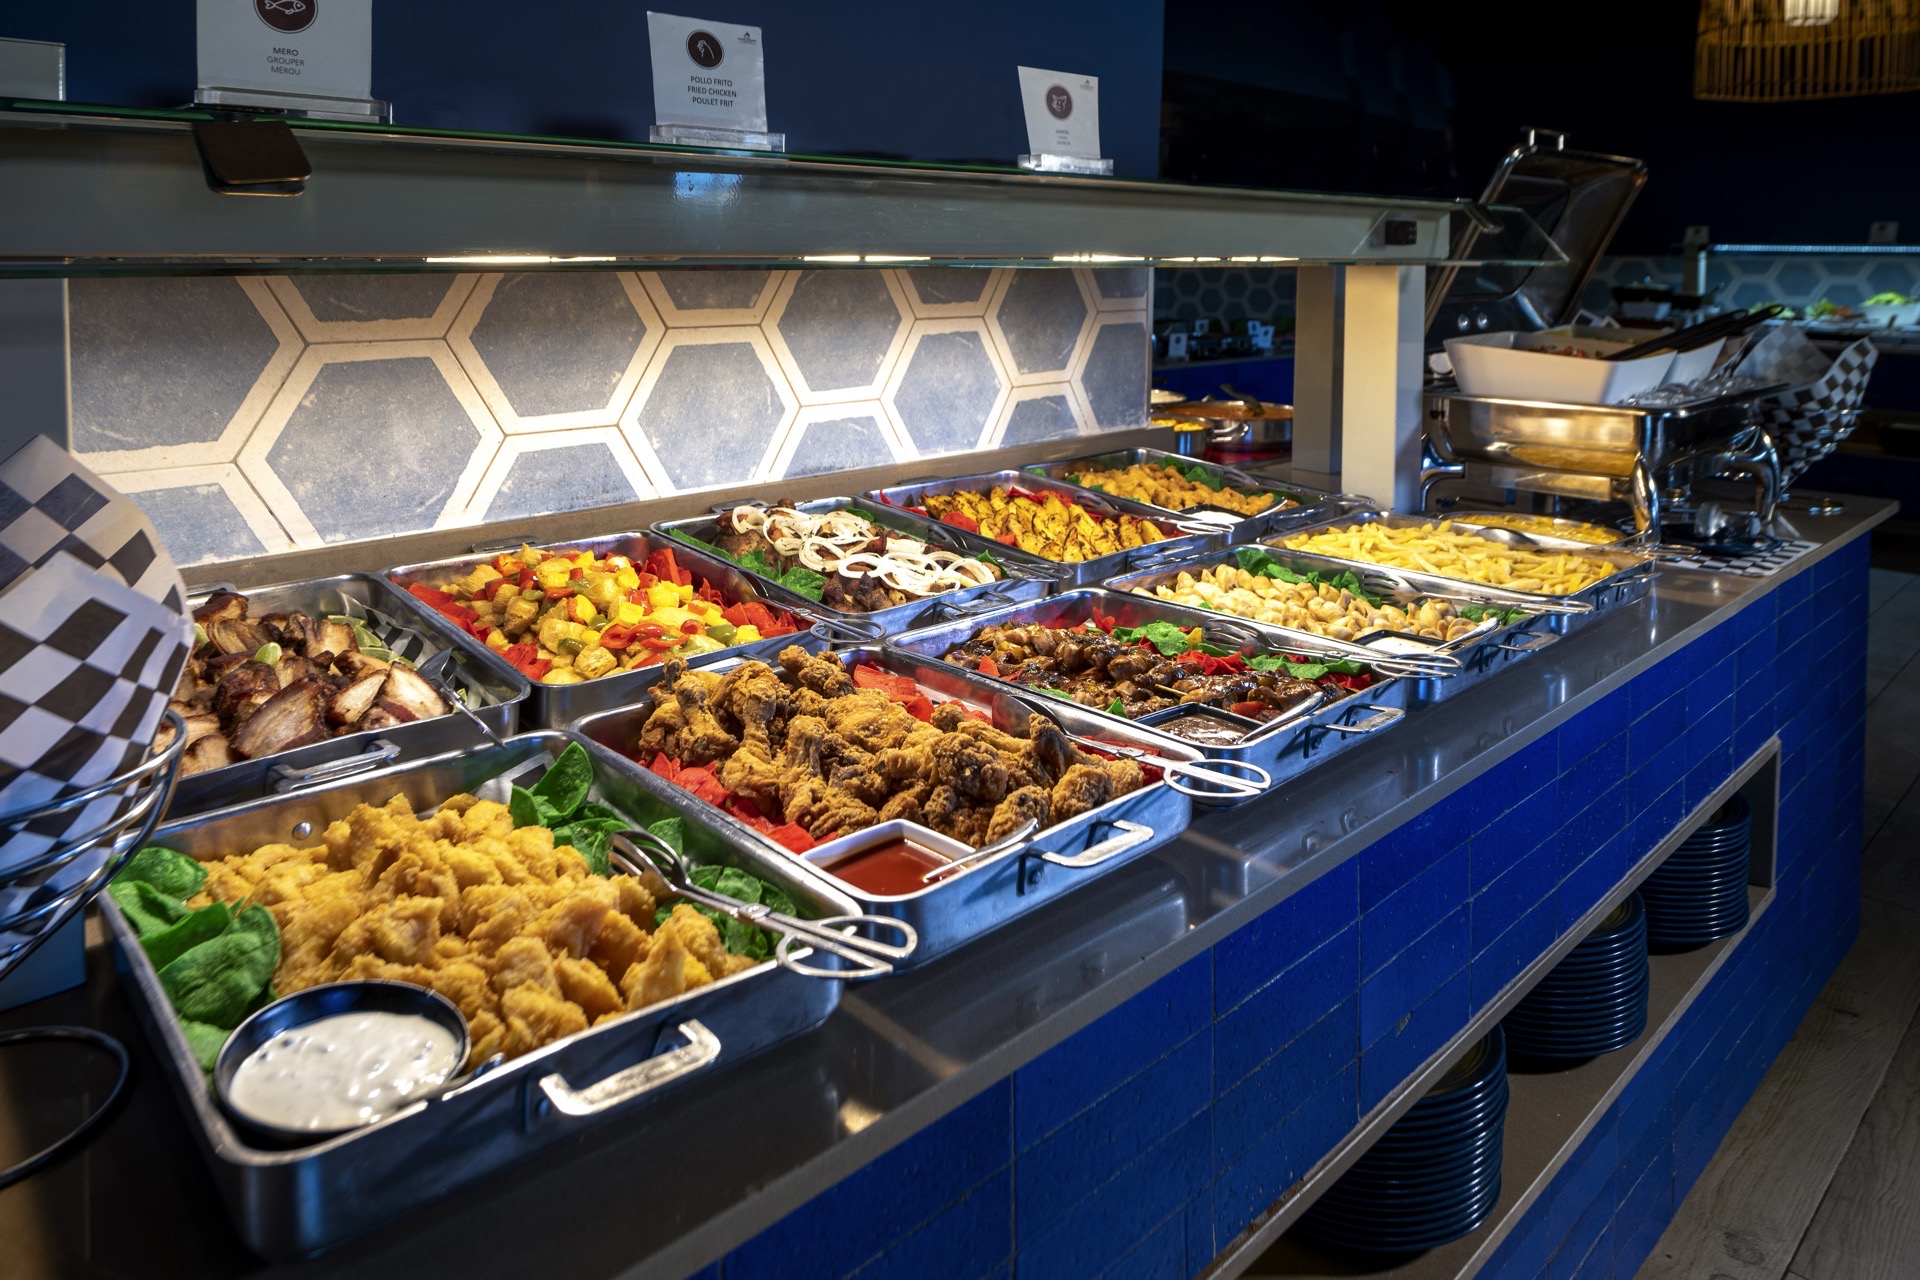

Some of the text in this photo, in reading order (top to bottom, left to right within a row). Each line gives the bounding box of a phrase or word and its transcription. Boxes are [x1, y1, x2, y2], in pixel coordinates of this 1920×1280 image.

[273, 47, 299, 56] MERO
[267, 56, 304, 66] GROUPER
[690, 75, 733, 87] POLLO FRITO
[687, 85, 737, 97] FRIED CHICKEN
[692, 96, 718, 106] POULET
